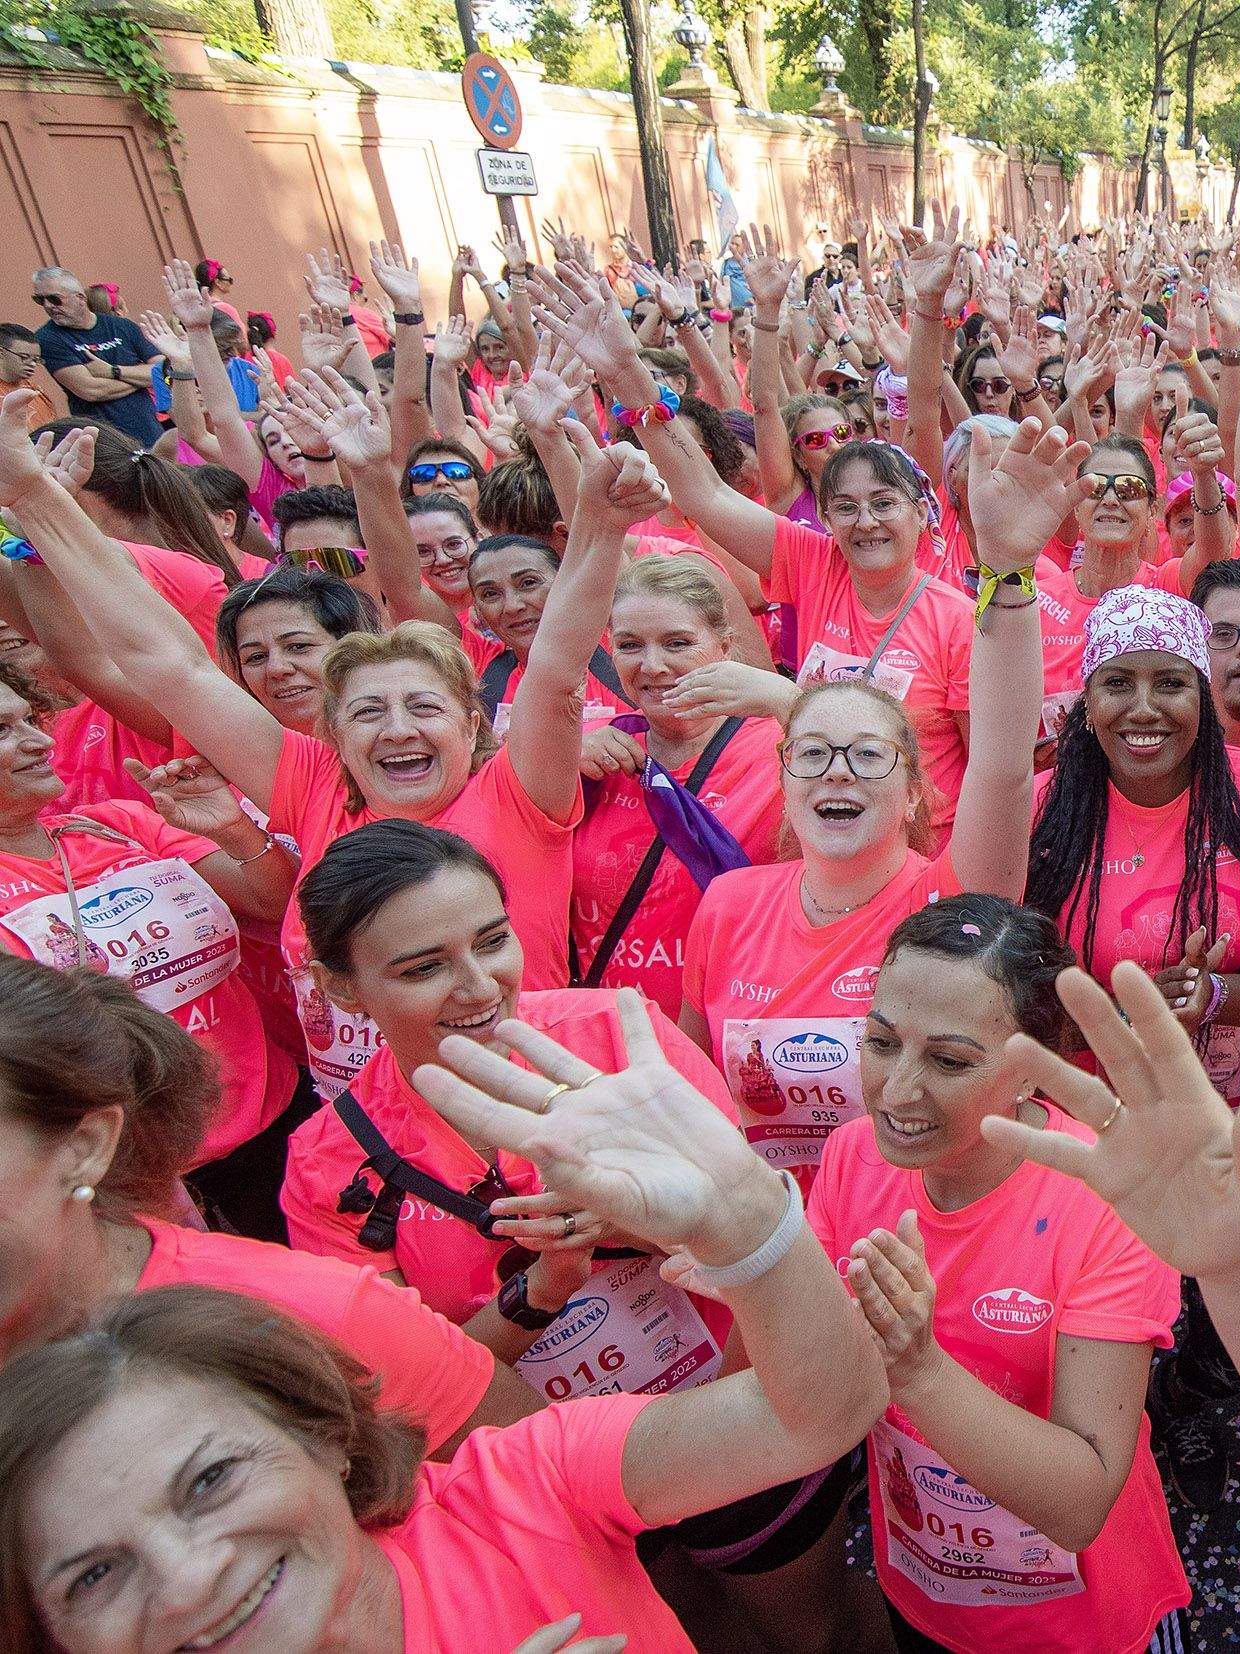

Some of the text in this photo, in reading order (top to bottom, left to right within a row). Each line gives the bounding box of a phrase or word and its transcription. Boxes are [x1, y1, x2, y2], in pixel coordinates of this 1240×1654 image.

[489, 157, 528, 171] ZONA DE
[487, 173, 534, 187] SEGURIDAD
[1036, 589, 1072, 626] ERCHE
[1042, 634, 1082, 647] OYSHO
[882, 655, 919, 667] ASTURIANA
[153, 874, 186, 888] SUMA
[80, 893, 150, 926] ASTURIANA
[106, 920, 171, 959] 016
[131, 947, 170, 972] 3035
[206, 943, 226, 959] 2023
[134, 954, 204, 987] DE LA MUJER
[187, 960, 231, 988] Santander
[837, 980, 872, 993] ASTUR
[778, 1047, 843, 1063] ASTURIANA
[315, 1060, 346, 1077] CARRERA
[787, 1085, 847, 1106] 016
[811, 1110, 840, 1123] 935
[765, 1127, 811, 1136] CARRERA
[813, 1127, 826, 1136] DE
[765, 1144, 819, 1159] OYSHO
[398, 1199, 446, 1221] OYS
[610, 1262, 650, 1292] SUMA
[978, 1300, 1048, 1324] ASTURIANA
[544, 1343, 625, 1400] 016
[670, 1356, 698, 1382] 2023
[919, 1471, 993, 1506] ASTURIANA
[926, 1512, 995, 1548] 016
[901, 1535, 943, 1572] CARRERA
[943, 1565, 960, 1577] DE
[962, 1567, 979, 1578] LA
[981, 1569, 1023, 1584] MUJER
[1028, 1575, 1056, 1584] 2023
[941, 1546, 986, 1566] 2962
[900, 1552, 945, 1594] OYSHO
[998, 1585, 1066, 1598] Santander
